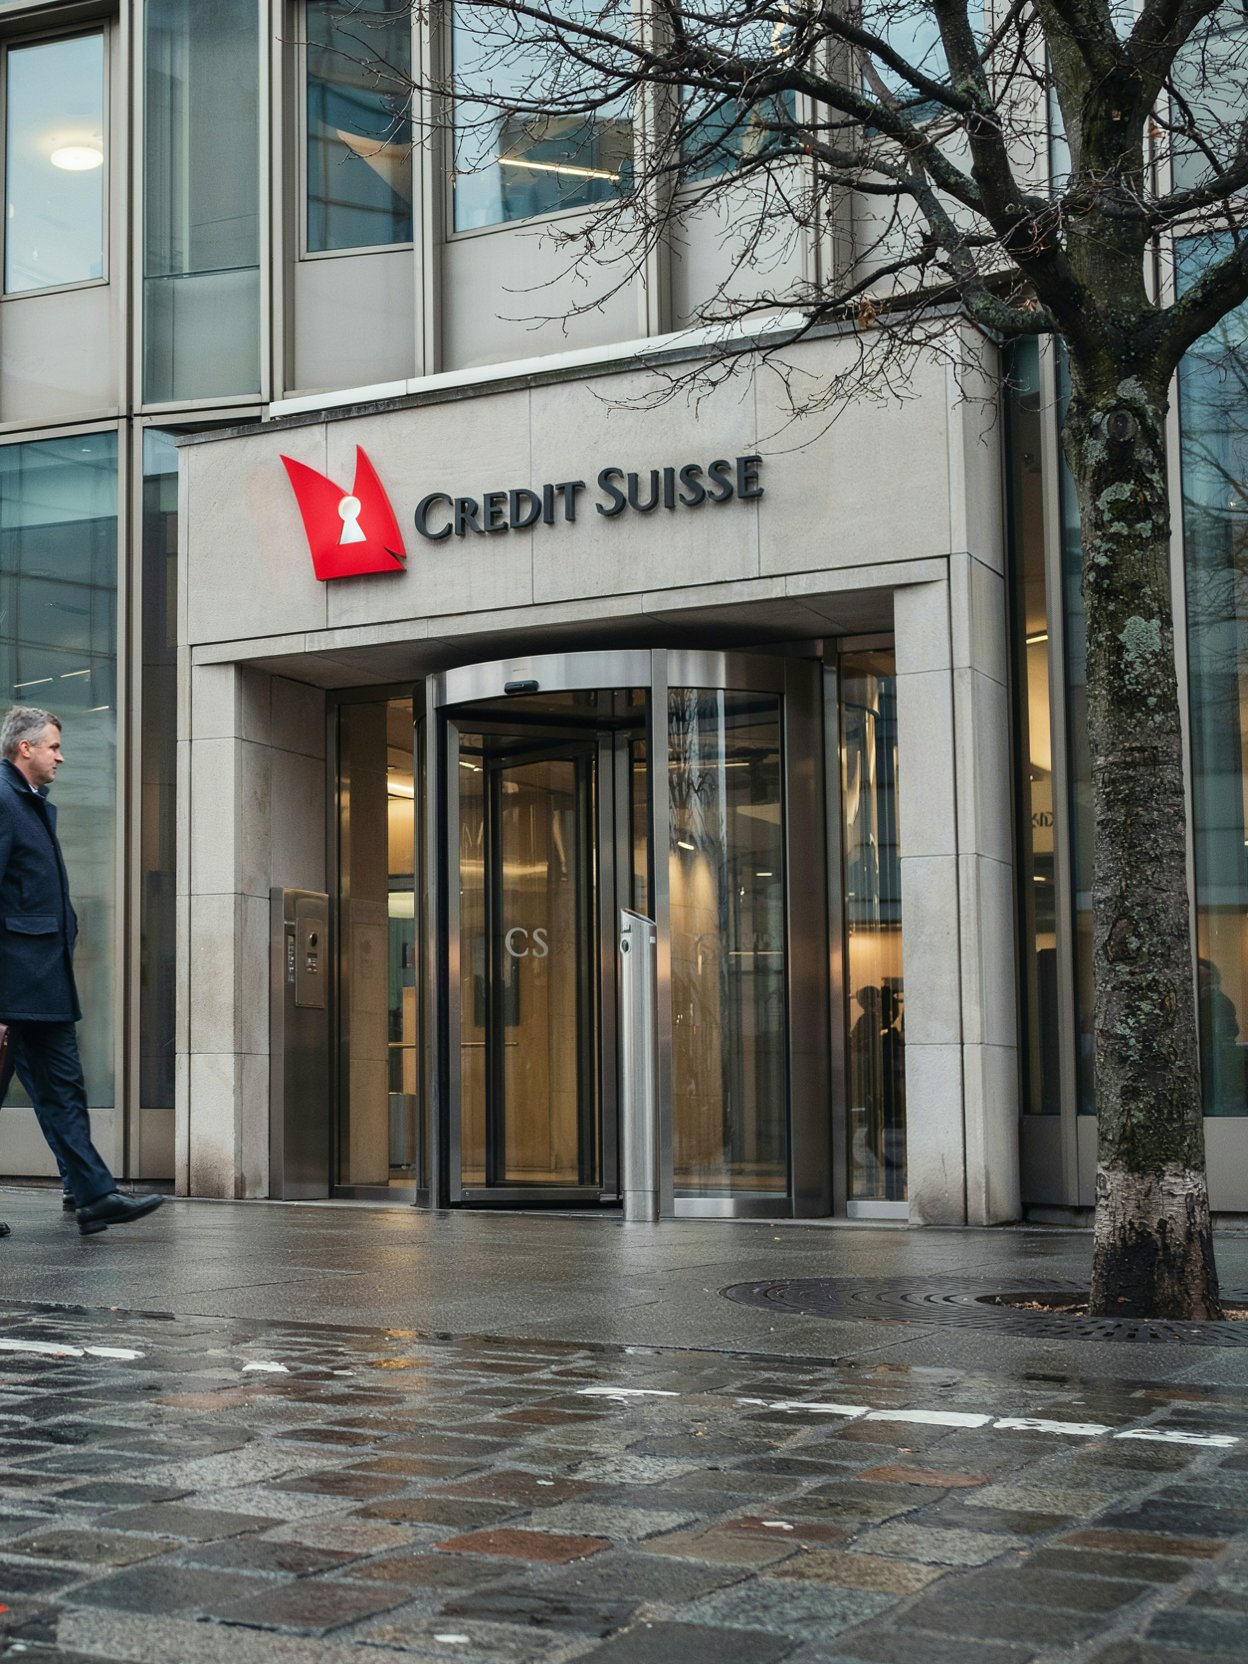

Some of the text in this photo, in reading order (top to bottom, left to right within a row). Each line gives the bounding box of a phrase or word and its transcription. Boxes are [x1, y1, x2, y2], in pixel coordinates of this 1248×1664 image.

[414, 455, 764, 541] CREDIT SUISSE
[505, 927, 549, 957] CS
